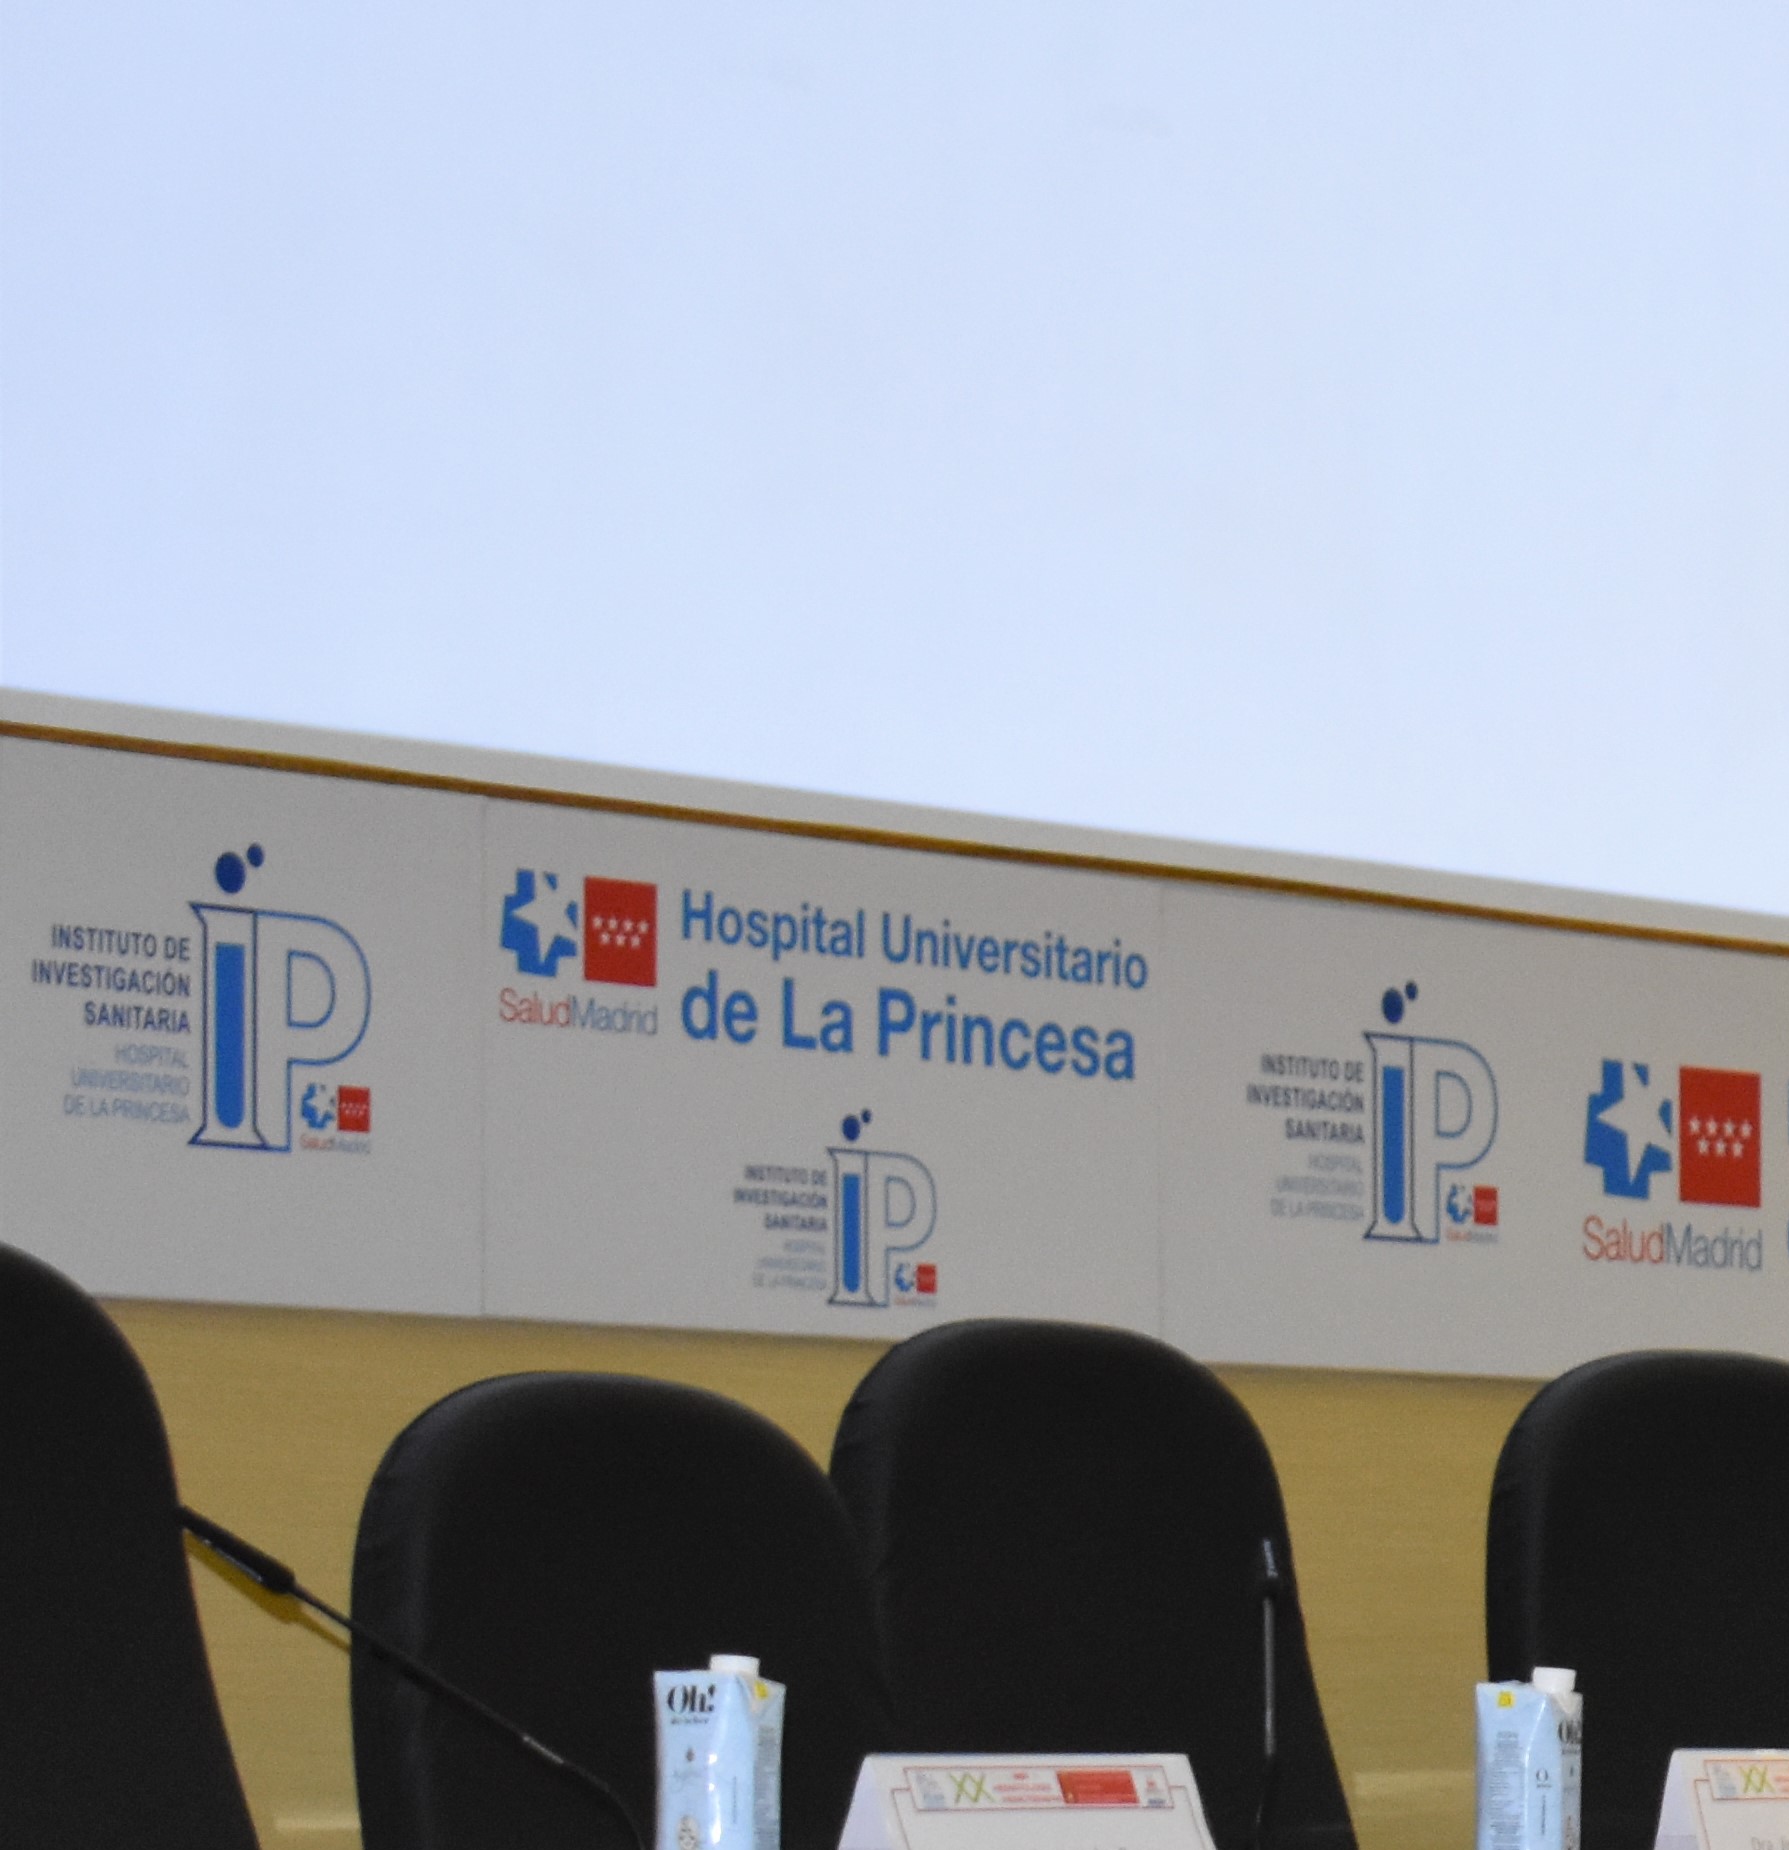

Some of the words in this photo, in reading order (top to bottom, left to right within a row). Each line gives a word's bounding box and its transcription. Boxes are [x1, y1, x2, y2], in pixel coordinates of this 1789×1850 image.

[51, 924, 157, 959] INSTITUTO
[164, 936, 190, 961] DE
[681, 889, 865, 962] Hospital
[882, 913, 1148, 990] Universitario
[32, 958, 190, 998] INVESTIGACIÓN
[84, 1001, 190, 1034] SANITARIA
[500, 988, 658, 1035] SaludMadrid
[681, 969, 758, 1043] de
[782, 976, 854, 1054] La
[878, 987, 1135, 1082] Princesa
[1261, 1054, 1340, 1081] INSTITUTO
[1285, 1117, 1364, 1143] SANITARIA
[1583, 1215, 1762, 1273] SaludMadrid
